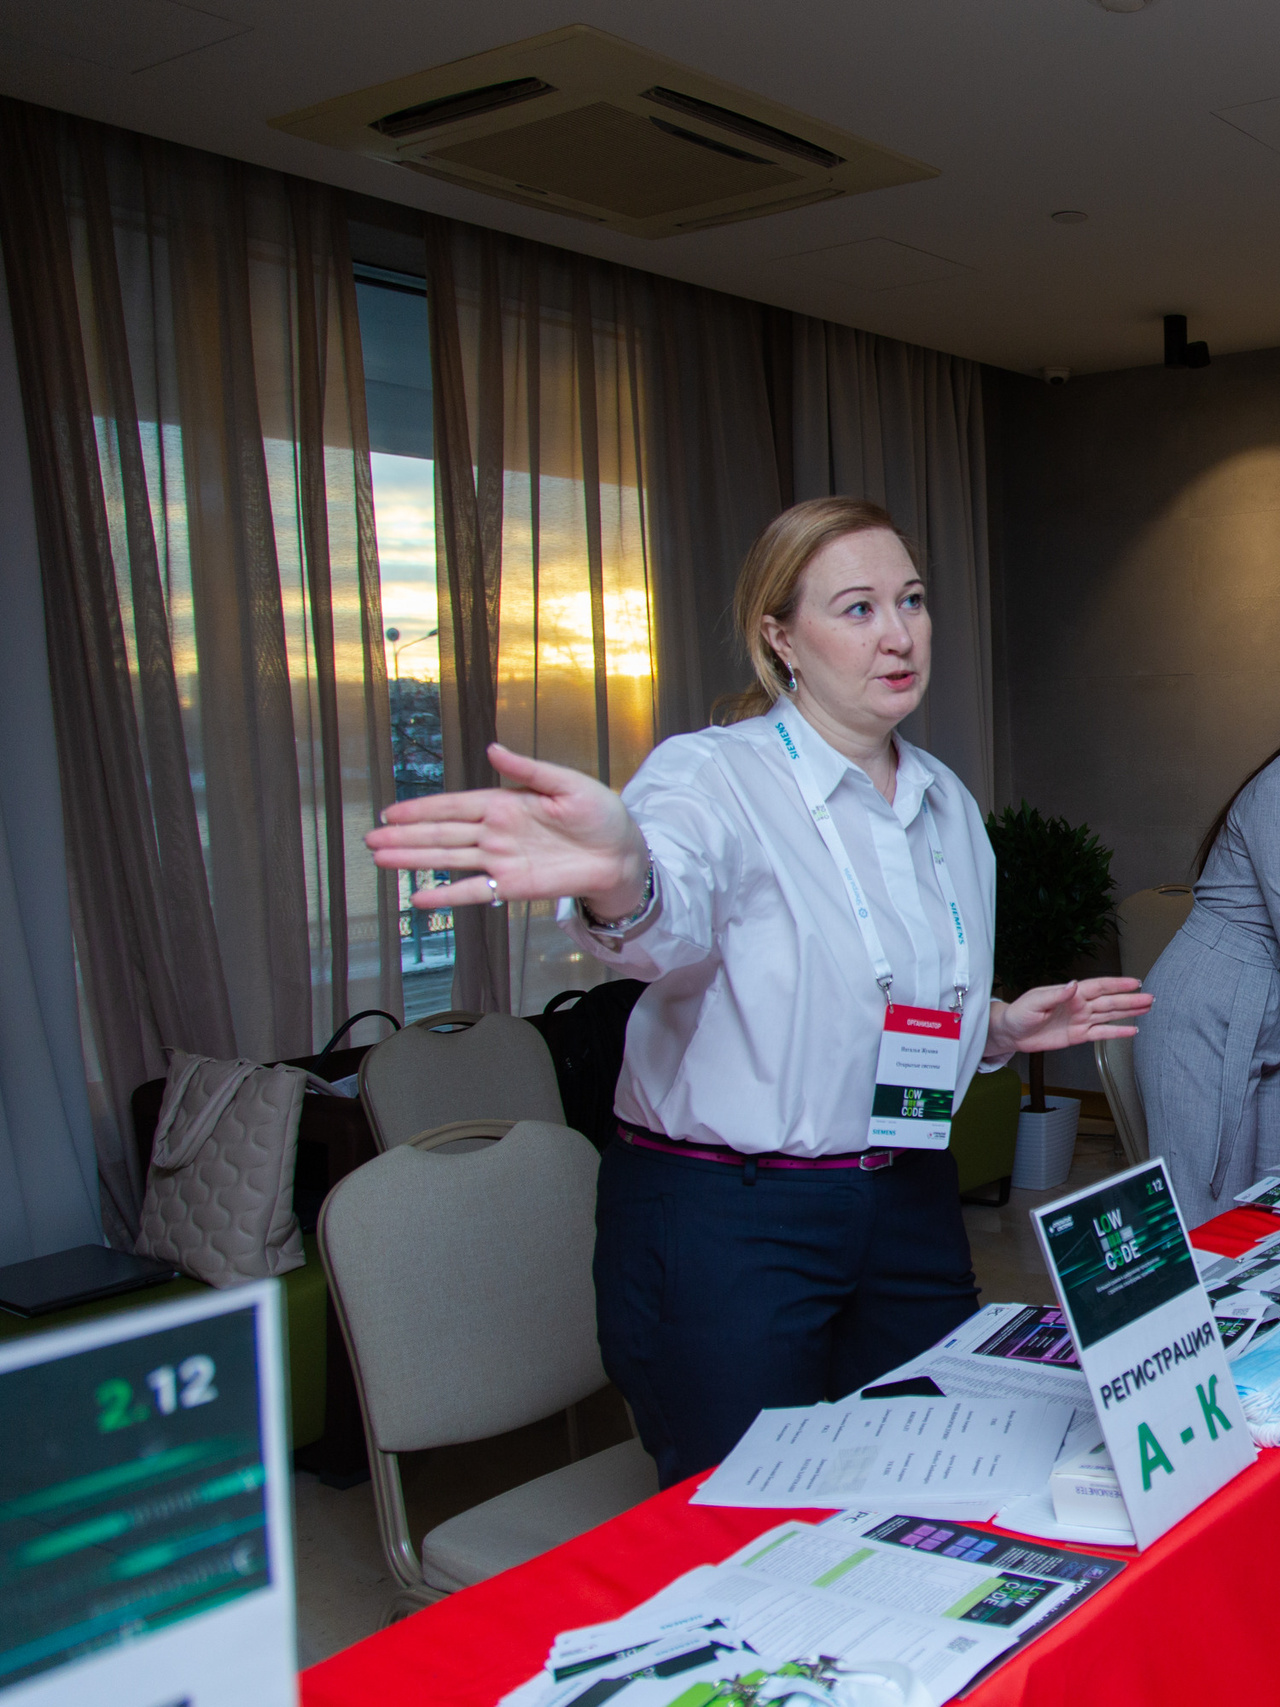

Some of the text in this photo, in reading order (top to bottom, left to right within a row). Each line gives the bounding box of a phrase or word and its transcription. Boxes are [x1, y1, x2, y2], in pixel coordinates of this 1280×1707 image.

[775, 722, 800, 760] SIEMENS
[949, 901, 965, 945] SIEMENS
[906, 1018, 942, 1030] ОРГАНИЗАТОР
[903, 1088, 923, 1100] LOW
[901, 1106, 924, 1118] CODE
[872, 1128, 896, 1137] SIEMENS
[1093, 1207, 1123, 1237] LOW
[1105, 1239, 1141, 1271] CODE
[1100, 1321, 1215, 1410] РЕГИСТРАЦИЯ
[94, 1353, 220, 1434] 2.12
[1075, 1485, 1123, 1499] HERMOMETER
[982, 1580, 1021, 1607] CODE
[1014, 1584, 1046, 1608] LOW
